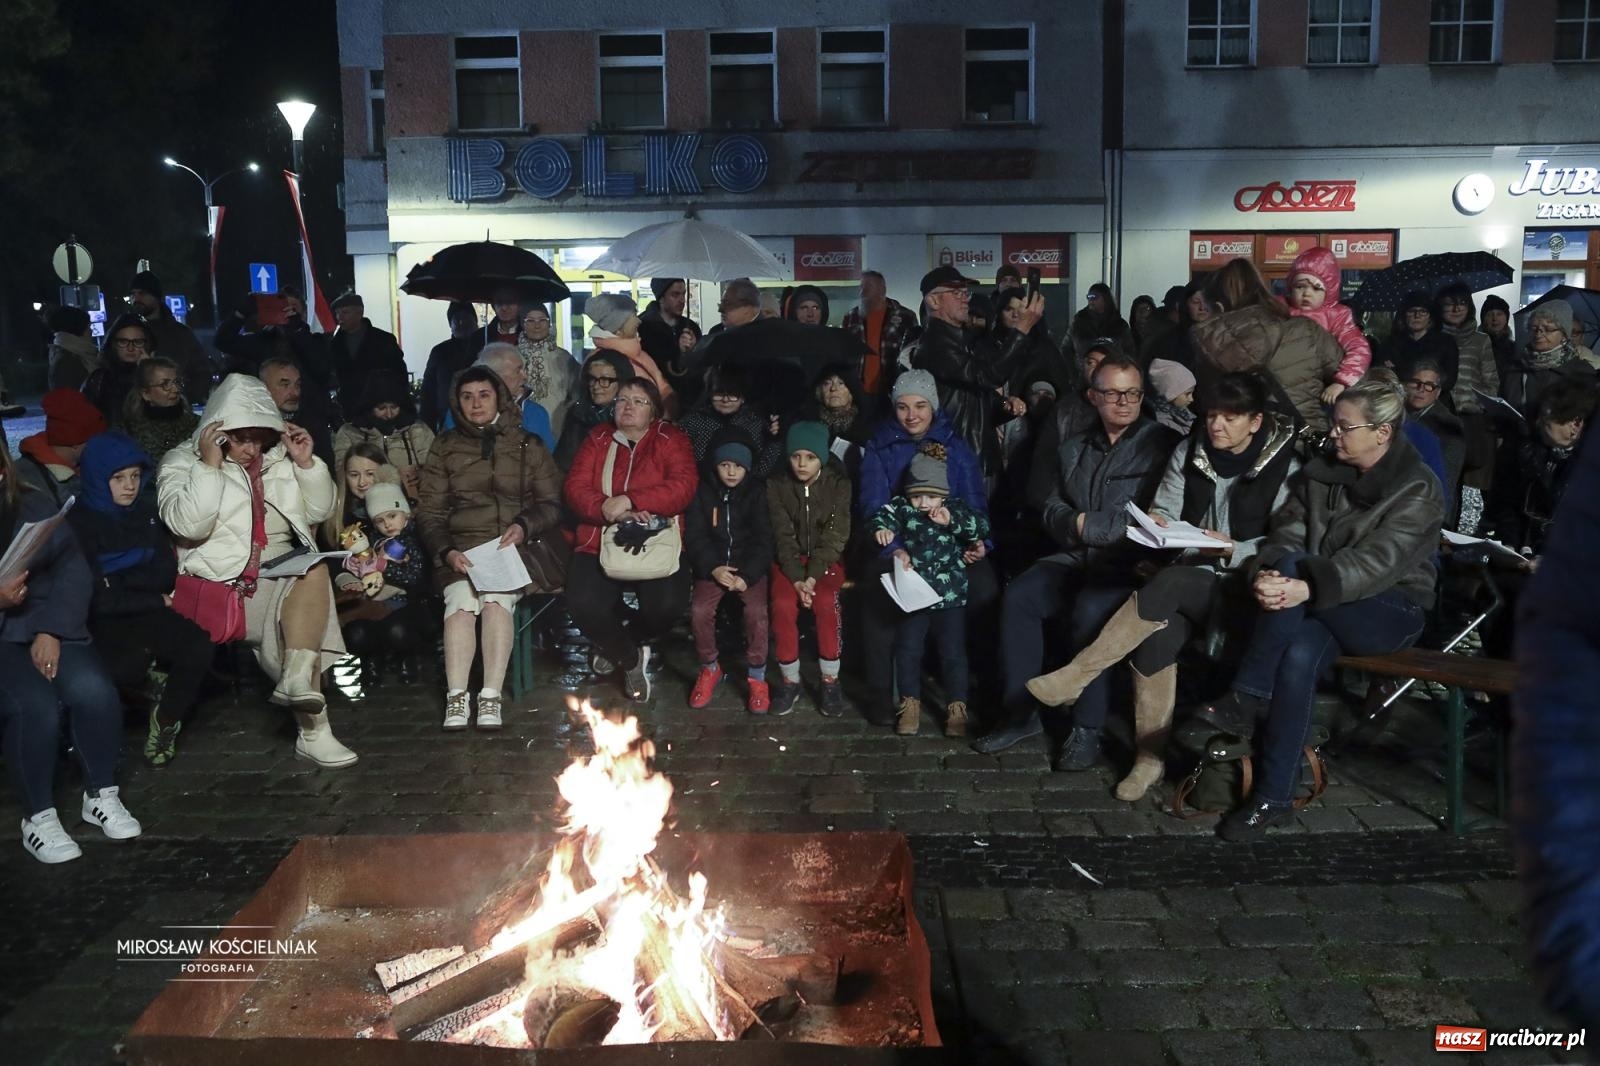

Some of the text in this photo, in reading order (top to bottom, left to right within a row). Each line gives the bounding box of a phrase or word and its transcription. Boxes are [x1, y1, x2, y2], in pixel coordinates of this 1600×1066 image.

[447, 135, 768, 199] BOLKO
[1509, 160, 1600, 195] JUB
[955, 250, 993, 263] Bliski
[170, 298, 182, 314] P
